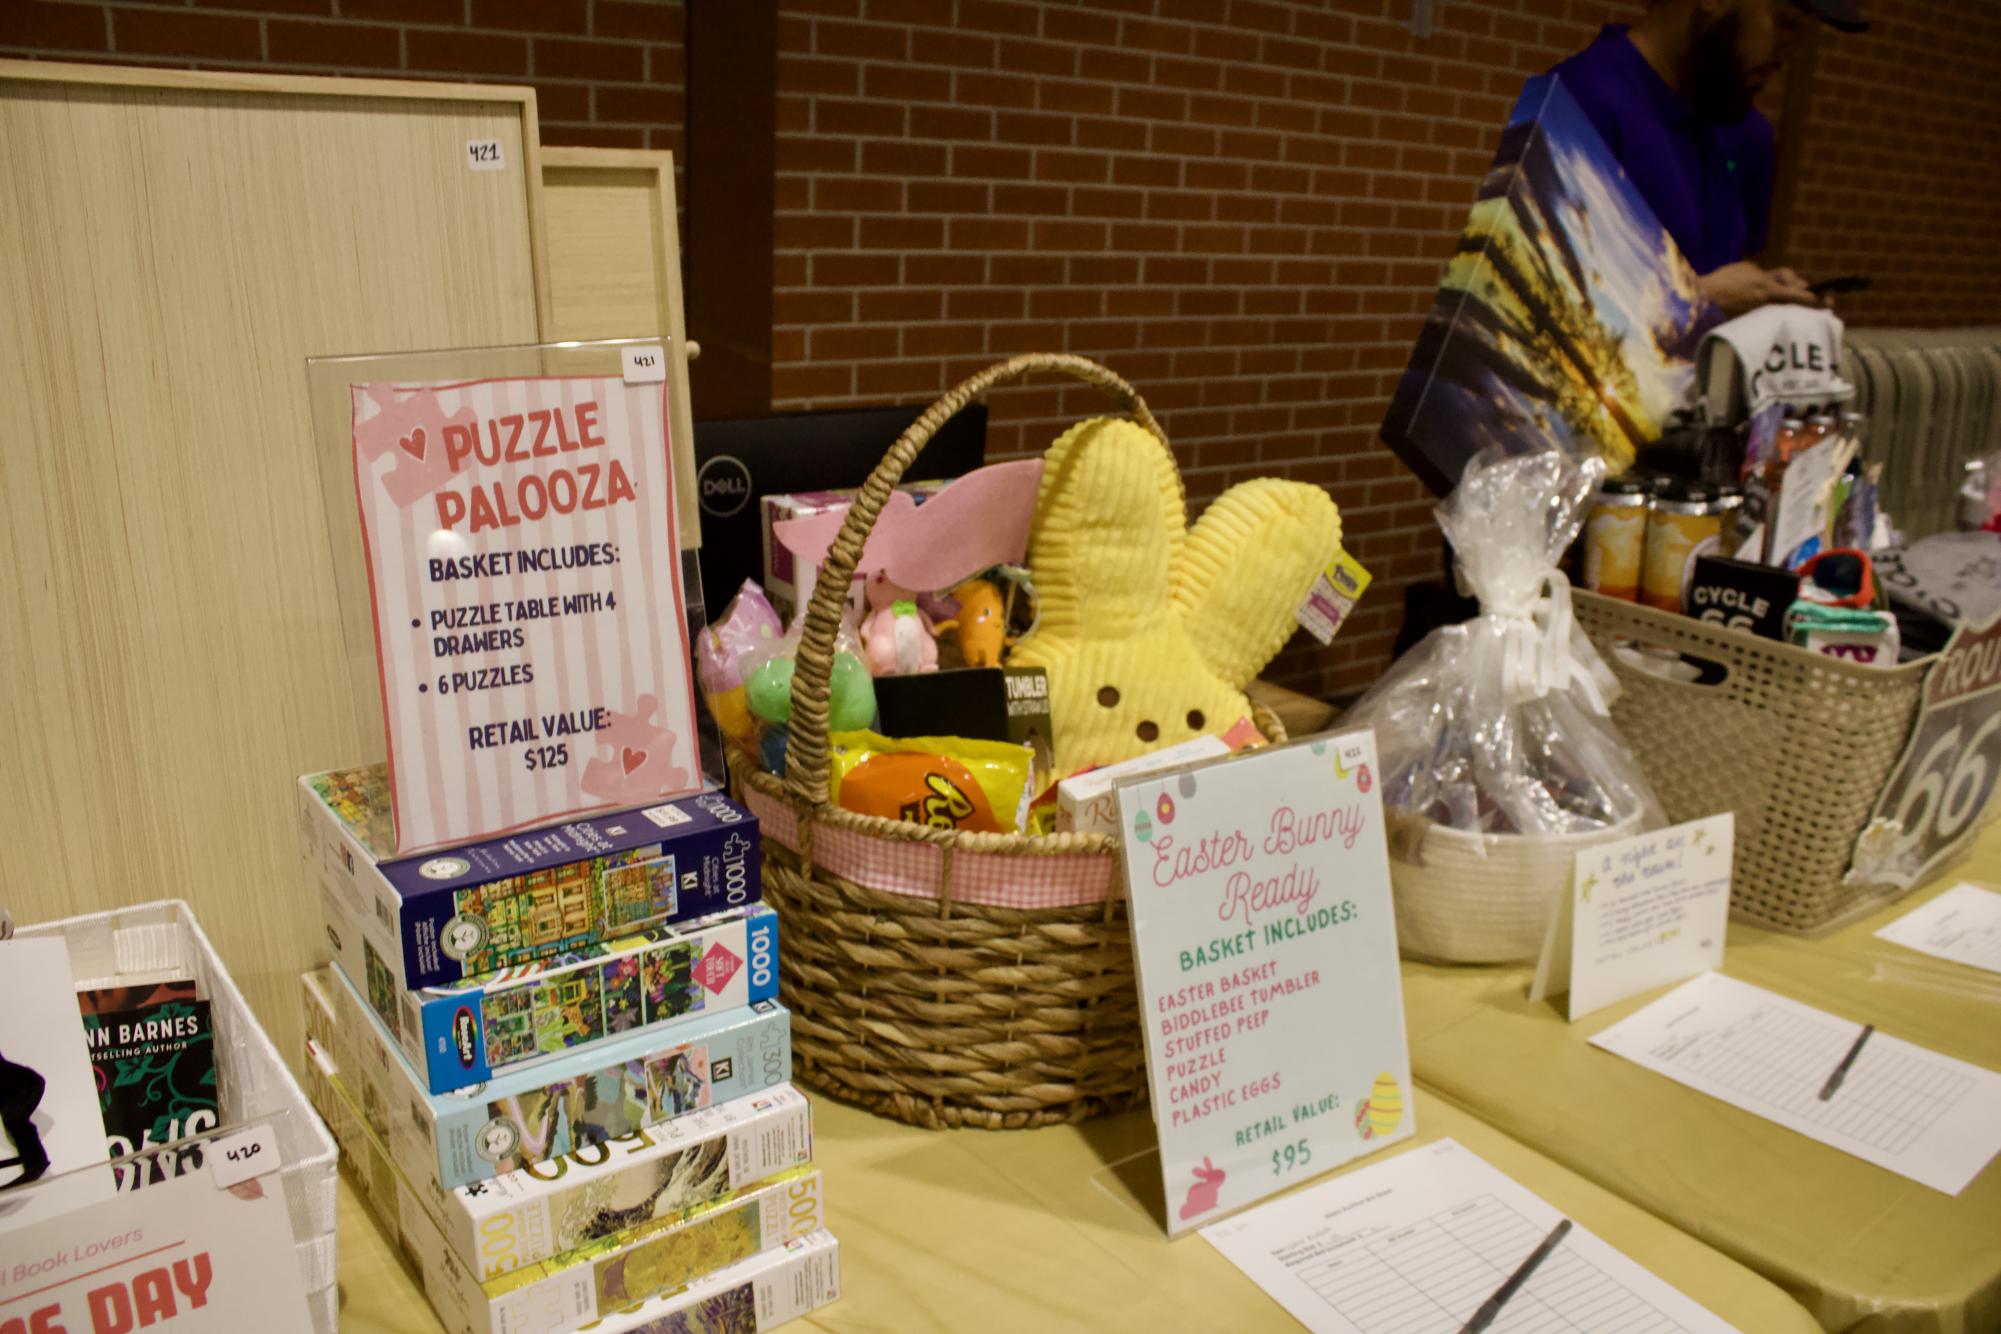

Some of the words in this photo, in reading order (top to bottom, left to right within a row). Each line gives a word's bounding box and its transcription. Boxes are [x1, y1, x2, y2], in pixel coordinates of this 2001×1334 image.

[469, 143, 500, 162] 421
[633, 354, 656, 368] 421
[442, 401, 606, 473] PUZZLE
[435, 460, 638, 534] PALOOZA
[428, 552, 513, 582] BASKET
[516, 543, 622, 572] INCLUDES:
[430, 602, 502, 631] PUZZLE
[504, 596, 561, 623] TABLE
[563, 594, 604, 616] WITH
[605, 592, 617, 611] 4
[1693, 585, 1770, 619] CYCLE
[433, 628, 525, 657] DRAWERS
[438, 675, 450, 695] 6
[451, 664, 534, 693] PUZZLES
[1005, 676, 1048, 699] TUMBLER
[468, 718, 540, 750] RETAIL
[542, 708, 612, 737] VALUE:
[524, 744, 569, 772] $125
[1148, 829, 1255, 888] Easter
[1263, 803, 1366, 858] Bunny
[725, 861, 747, 904] 1000
[1217, 861, 1321, 926] Ready
[751, 925, 772, 987] 1000
[1179, 930, 1256, 972] BASKET
[1264, 902, 1358, 947] INCLUDES:
[1157, 980, 1216, 1013] EASTER
[1220, 961, 1278, 993] BASKET
[1160, 995, 1245, 1037] BIDDLEBEE
[1250, 970, 1321, 1006] TUMBLER
[119, 1016, 199, 1045] BARNES
[145, 1041, 188, 1055] AUTHOR
[1165, 1025, 1231, 1059] STUFFED
[1236, 1009, 1270, 1038] PEEP
[1166, 1048, 1227, 1082] PUZZLE
[1168, 1070, 1223, 1105] CANDY
[1171, 1094, 1237, 1128] PLASTIC
[1240, 1072, 1282, 1105] EGGS
[1235, 1115, 1287, 1147] RETAIL
[1292, 1094, 1340, 1124] VALUE:
[226, 1142, 262, 1162] 420
[1271, 1139, 1312, 1178] $95
[13, 1251, 69, 1281] Book
[73, 1228, 144, 1262] Lovers
[86, 1251, 213, 1334] DAY
